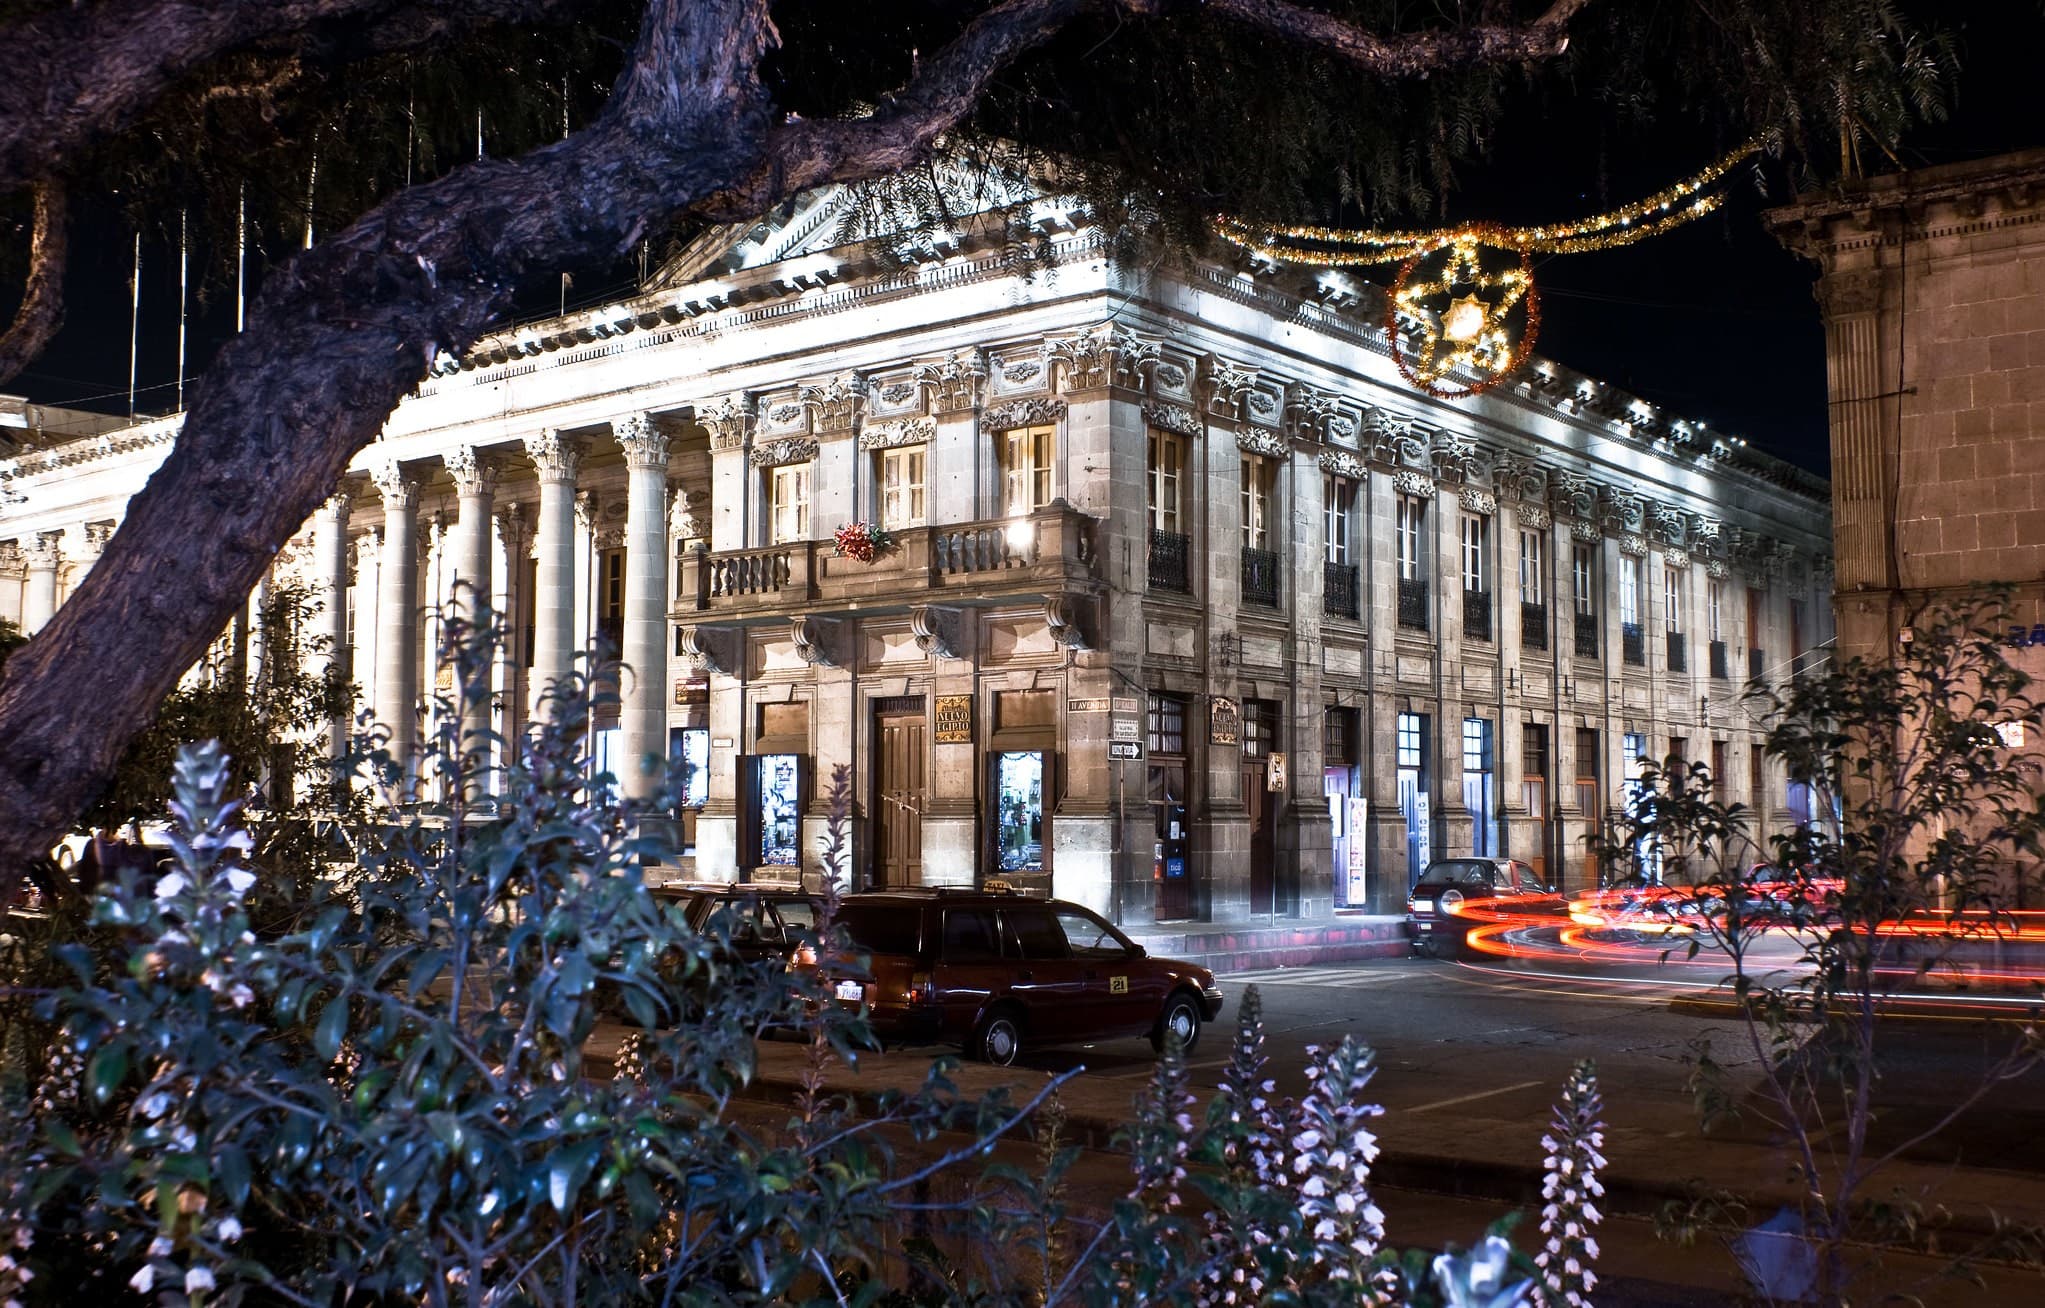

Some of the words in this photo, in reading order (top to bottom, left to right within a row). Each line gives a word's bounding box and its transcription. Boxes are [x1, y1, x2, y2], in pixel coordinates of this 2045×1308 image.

[1078, 700, 1108, 710] AVENIDA
[938, 711, 969, 721] NUEVO
[936, 721, 970, 732] EGIPTO
[1113, 980, 1124, 991] 21
